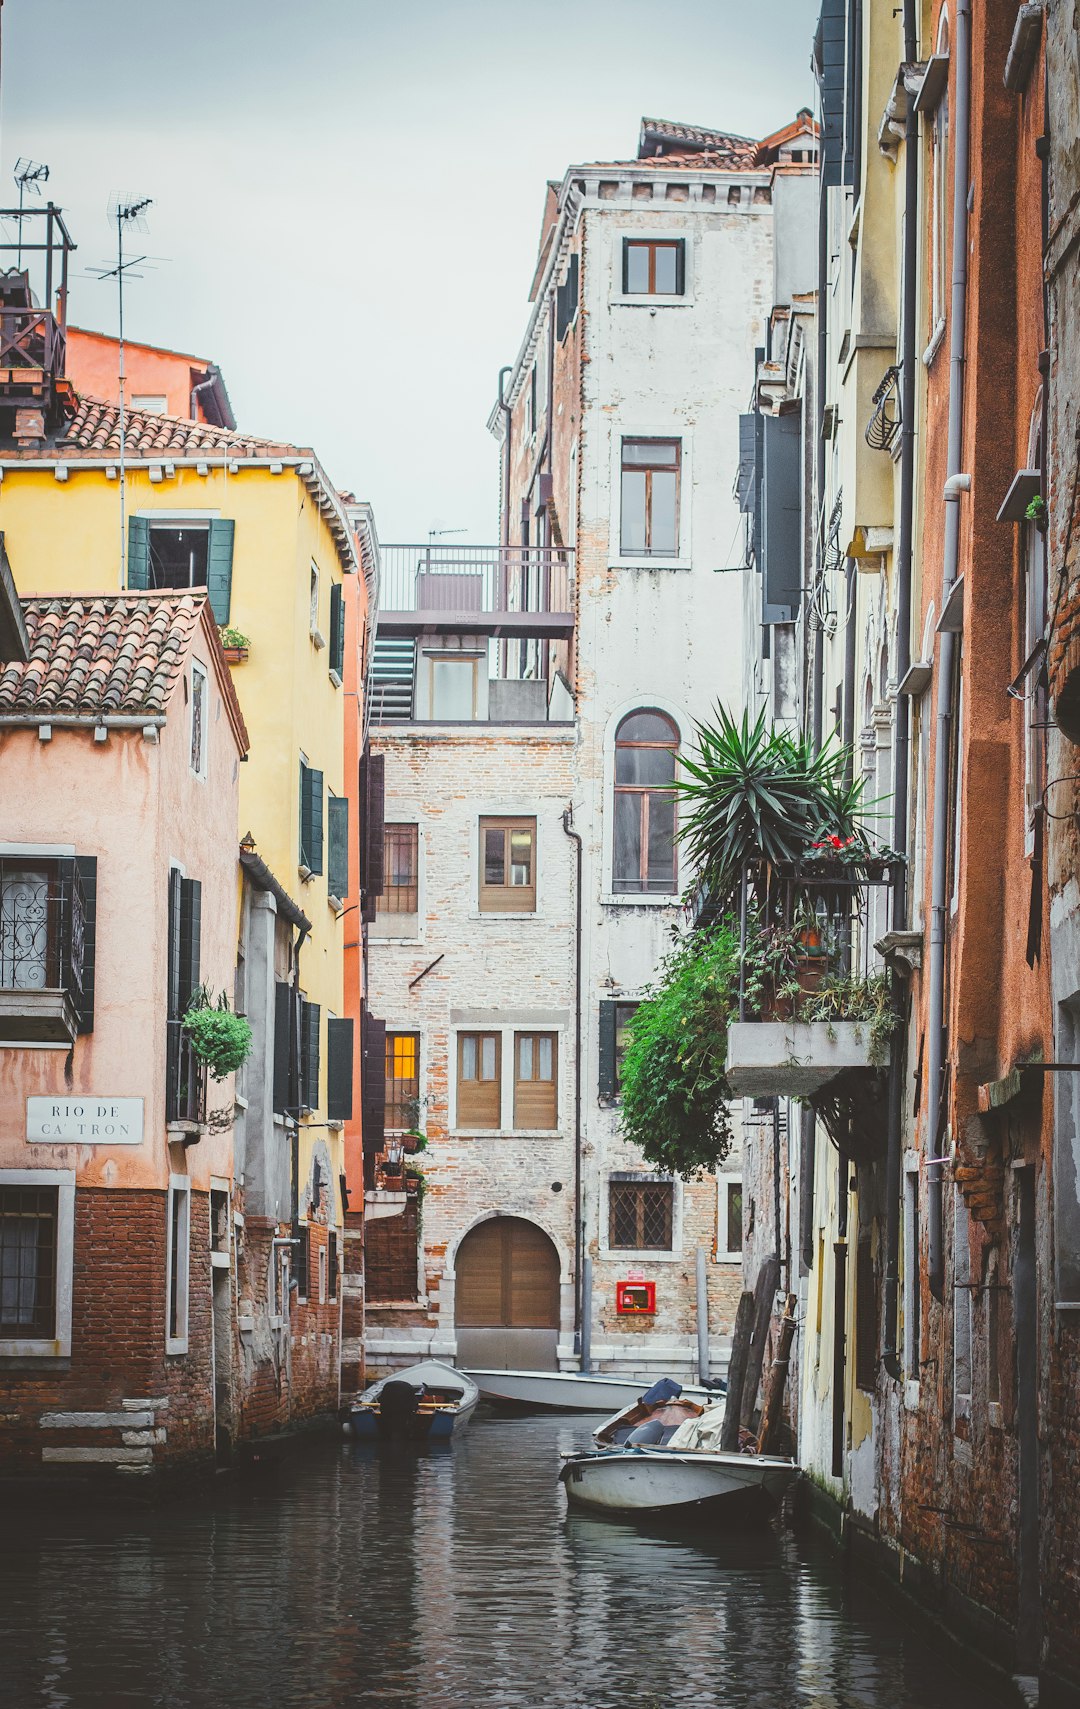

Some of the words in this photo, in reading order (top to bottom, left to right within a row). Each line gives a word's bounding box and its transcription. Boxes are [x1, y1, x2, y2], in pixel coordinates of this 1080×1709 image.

[52, 1106, 84, 1117] RIO
[97, 1106, 119, 1118] DE
[41, 1123, 67, 1135] CA'
[77, 1124, 130, 1135] TRON
